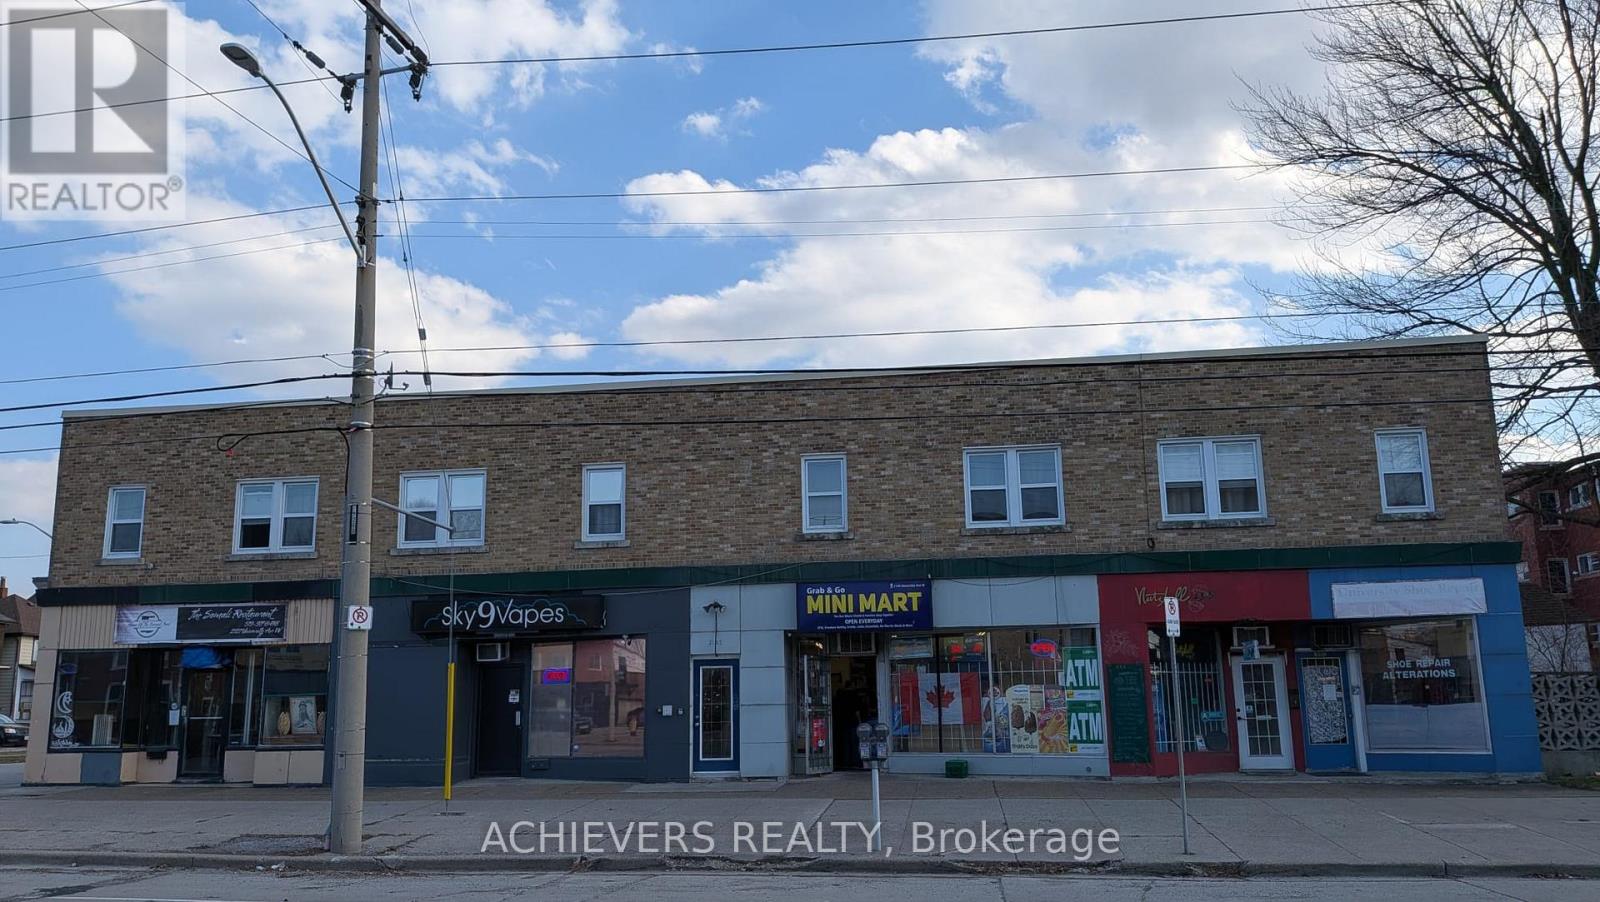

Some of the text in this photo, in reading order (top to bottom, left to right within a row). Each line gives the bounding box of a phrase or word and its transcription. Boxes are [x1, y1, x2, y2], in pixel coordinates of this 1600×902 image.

[806, 586, 846, 595] Grab & Go
[1135, 585, 1190, 606] Nutsll
[807, 592, 922, 614] MINI MART
[1066, 659, 1099, 687] ATM
[1387, 658, 1451, 668] SHOE REPAIR
[1383, 669, 1456, 680] ALTERATIONS
[1069, 712, 1103, 740] ATM
